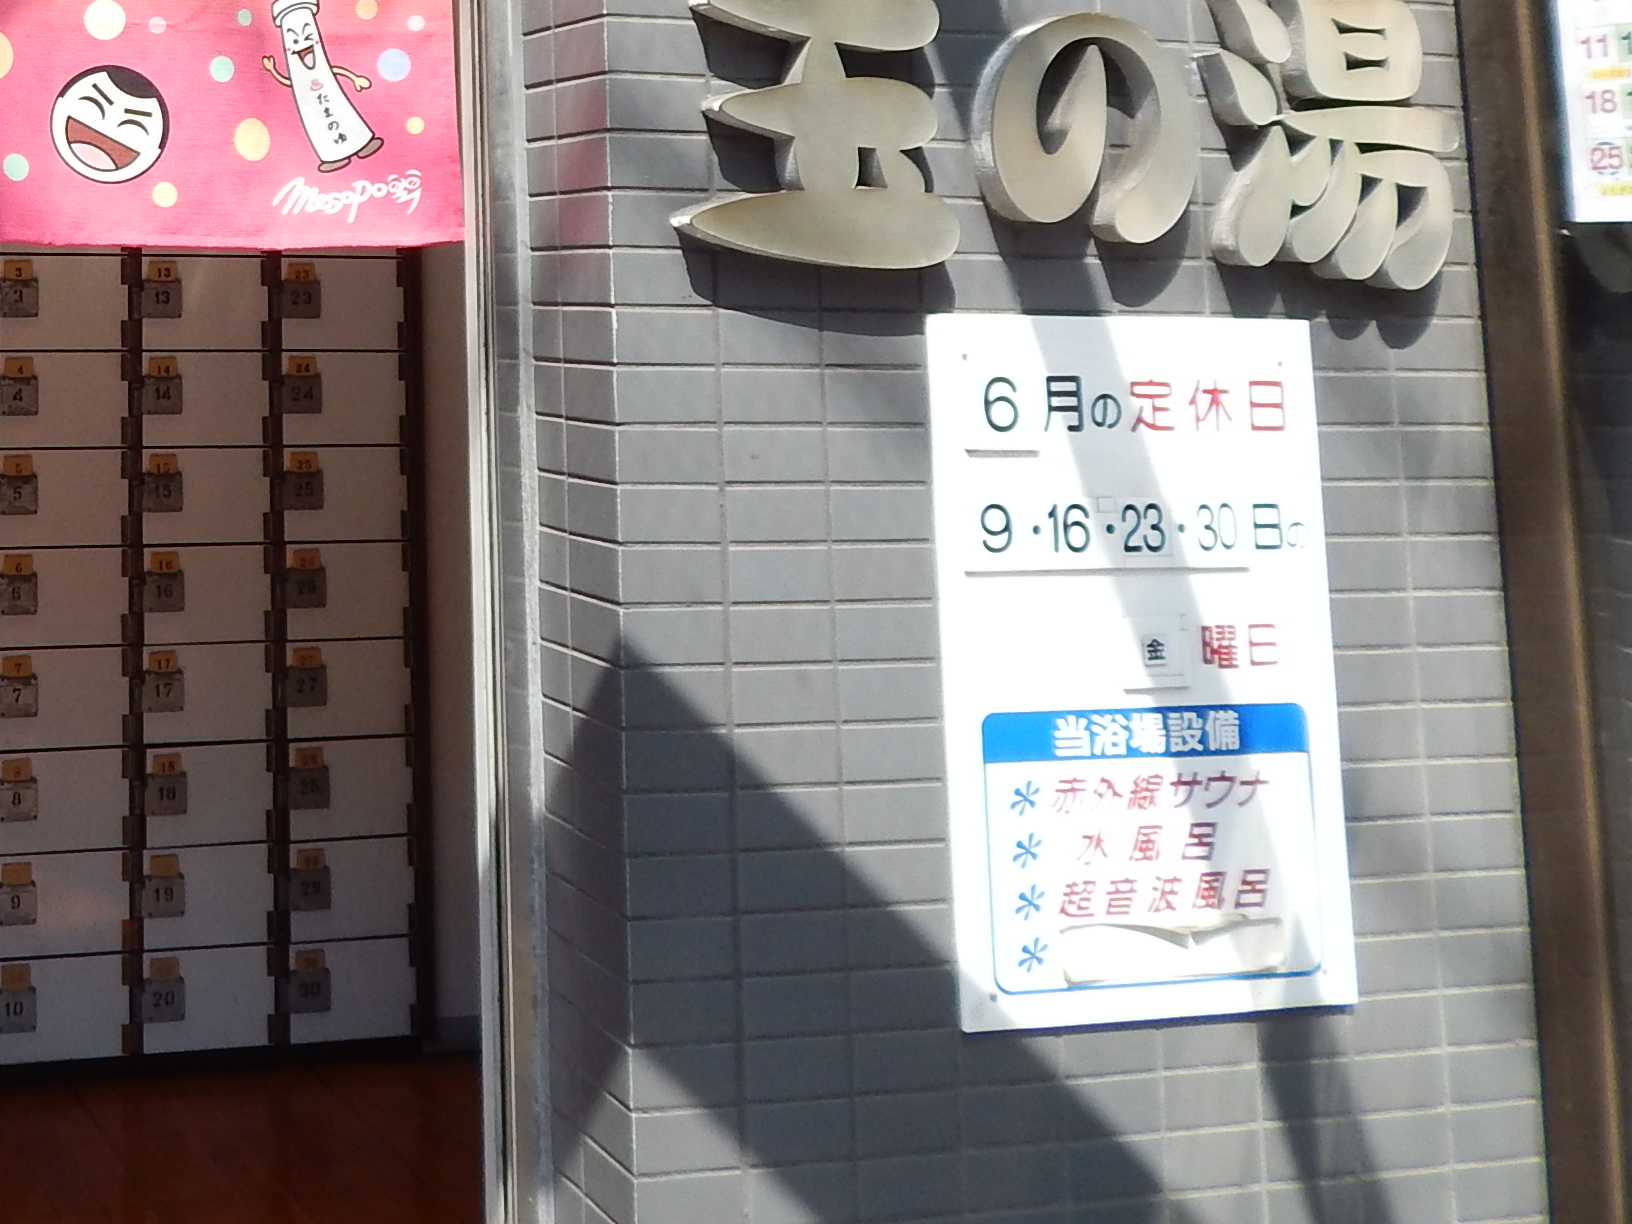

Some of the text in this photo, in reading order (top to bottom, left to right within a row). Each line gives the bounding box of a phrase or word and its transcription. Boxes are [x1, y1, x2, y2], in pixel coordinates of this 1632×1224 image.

[1580, 27, 1609, 60] 11
[1584, 89, 1618, 114] 18
[316, 92, 348, 146] たまのゆ
[1589, 145, 1626, 171] 25
[154, 290, 171, 305] 13
[290, 290, 313, 306] 23
[154, 386, 172, 402] 14
[290, 386, 314, 402] 24
[983, 374, 1286, 434] 6月の定休日
[154, 484, 173, 499] 15
[294, 482, 315, 497] 25
[155, 583, 174, 599] 16
[153, 682, 174, 698] 17
[295, 677, 318, 693] 27
[1054, 710, 1241, 757] 当浴場設備
[1052, 771, 1270, 814] 赤外線サウナ
[1077, 822, 1219, 865] 水風呂
[154, 887, 175, 903] 19
[1059, 869, 1270, 918] 超音波風呂
[299, 982, 321, 997] 30
[152, 991, 175, 1007] 20
[4, 1001, 24, 1017] 10
